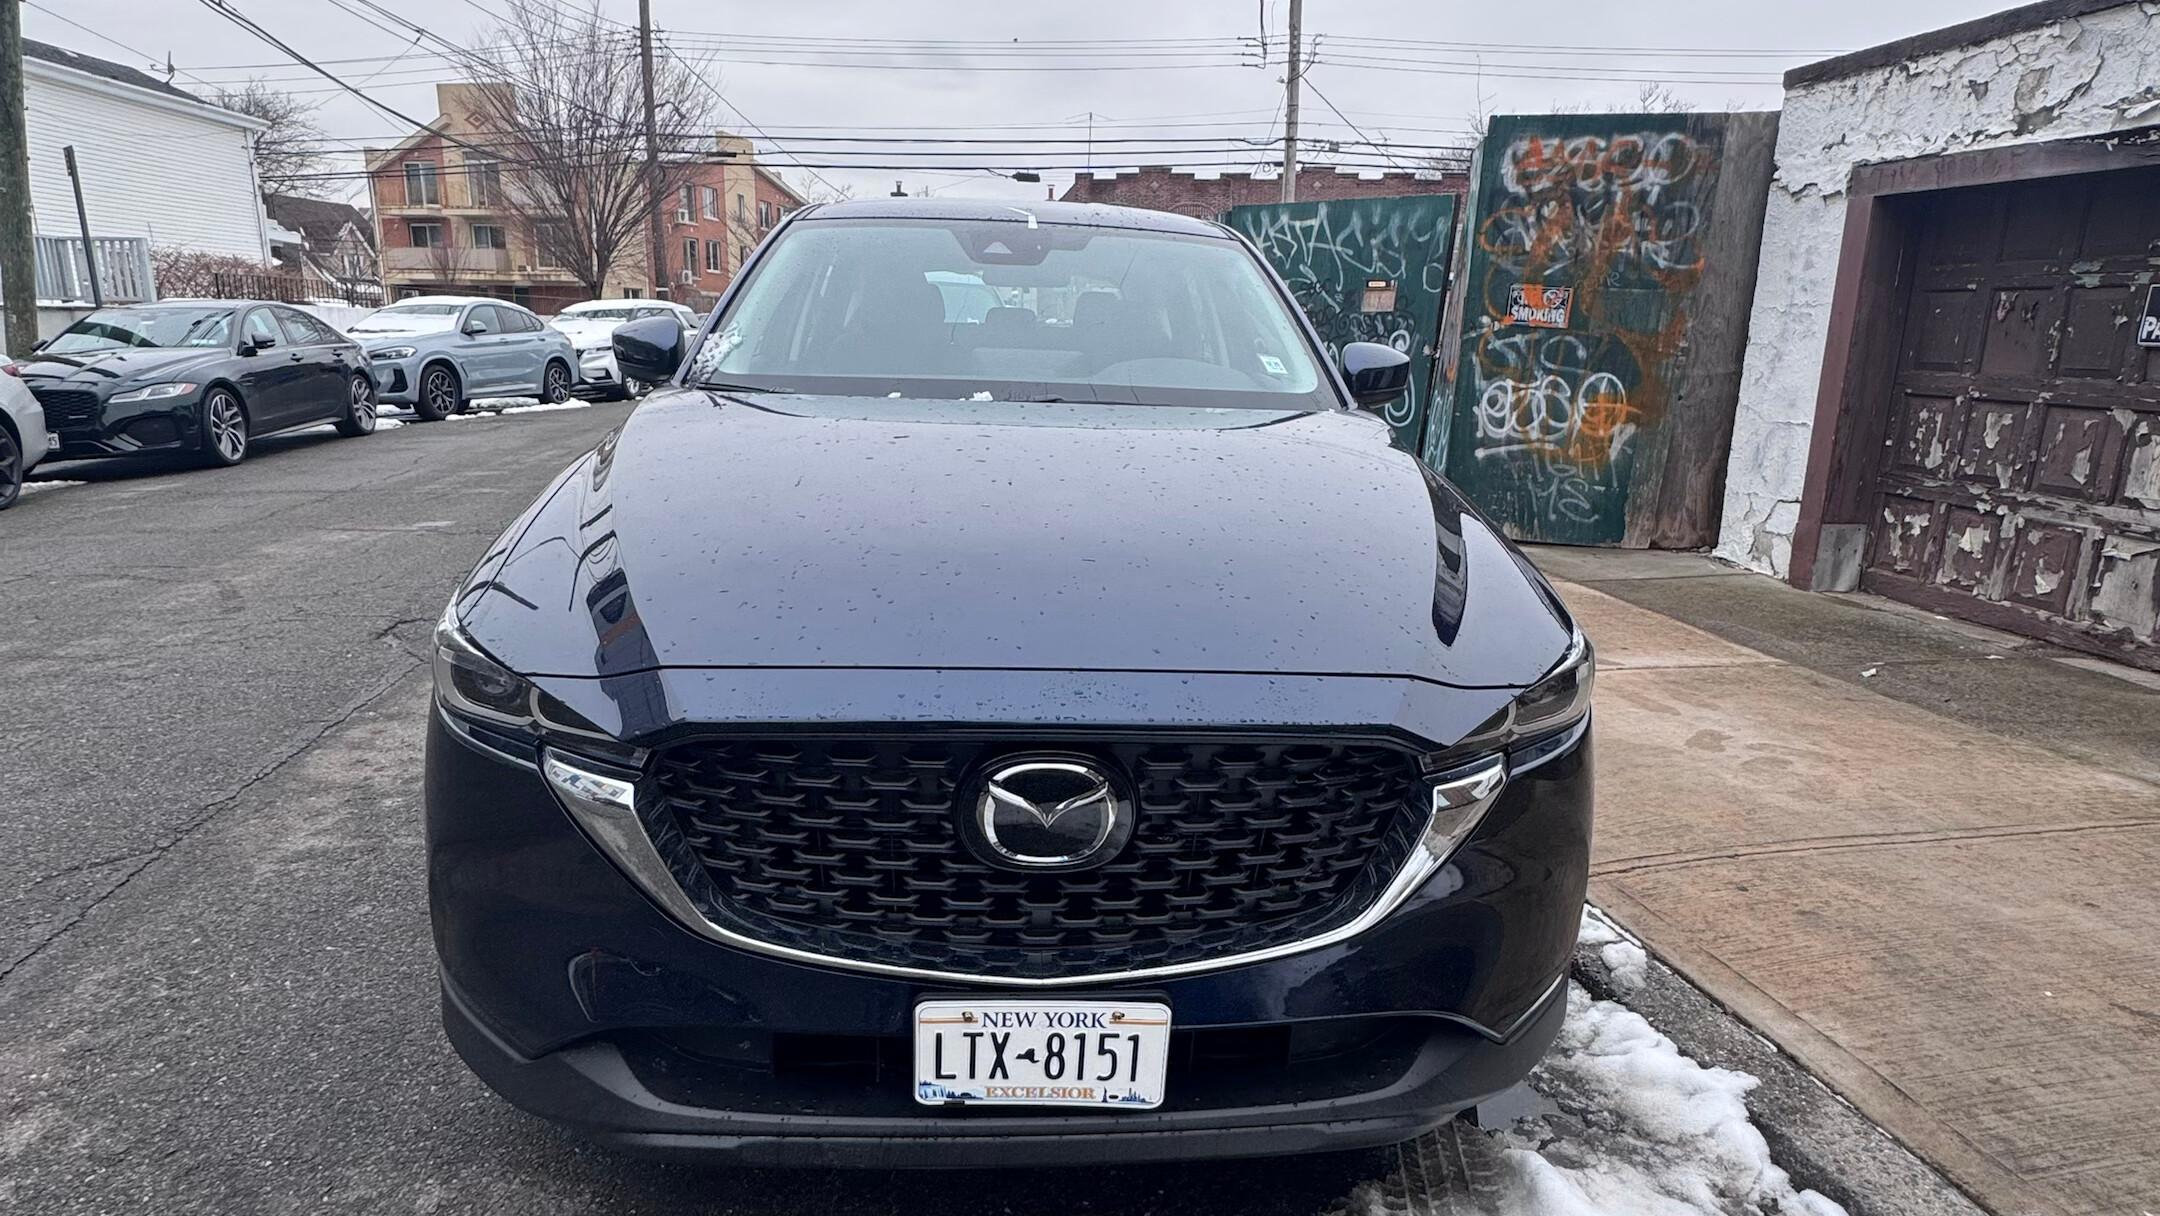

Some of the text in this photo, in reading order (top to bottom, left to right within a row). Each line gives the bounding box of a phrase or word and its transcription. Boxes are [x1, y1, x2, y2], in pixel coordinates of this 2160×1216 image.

[1511, 305, 1565, 323] SMOKING
[982, 1011, 1107, 1029] NEW YORK
[983, 1086, 1096, 1100] EXCELSIOR
